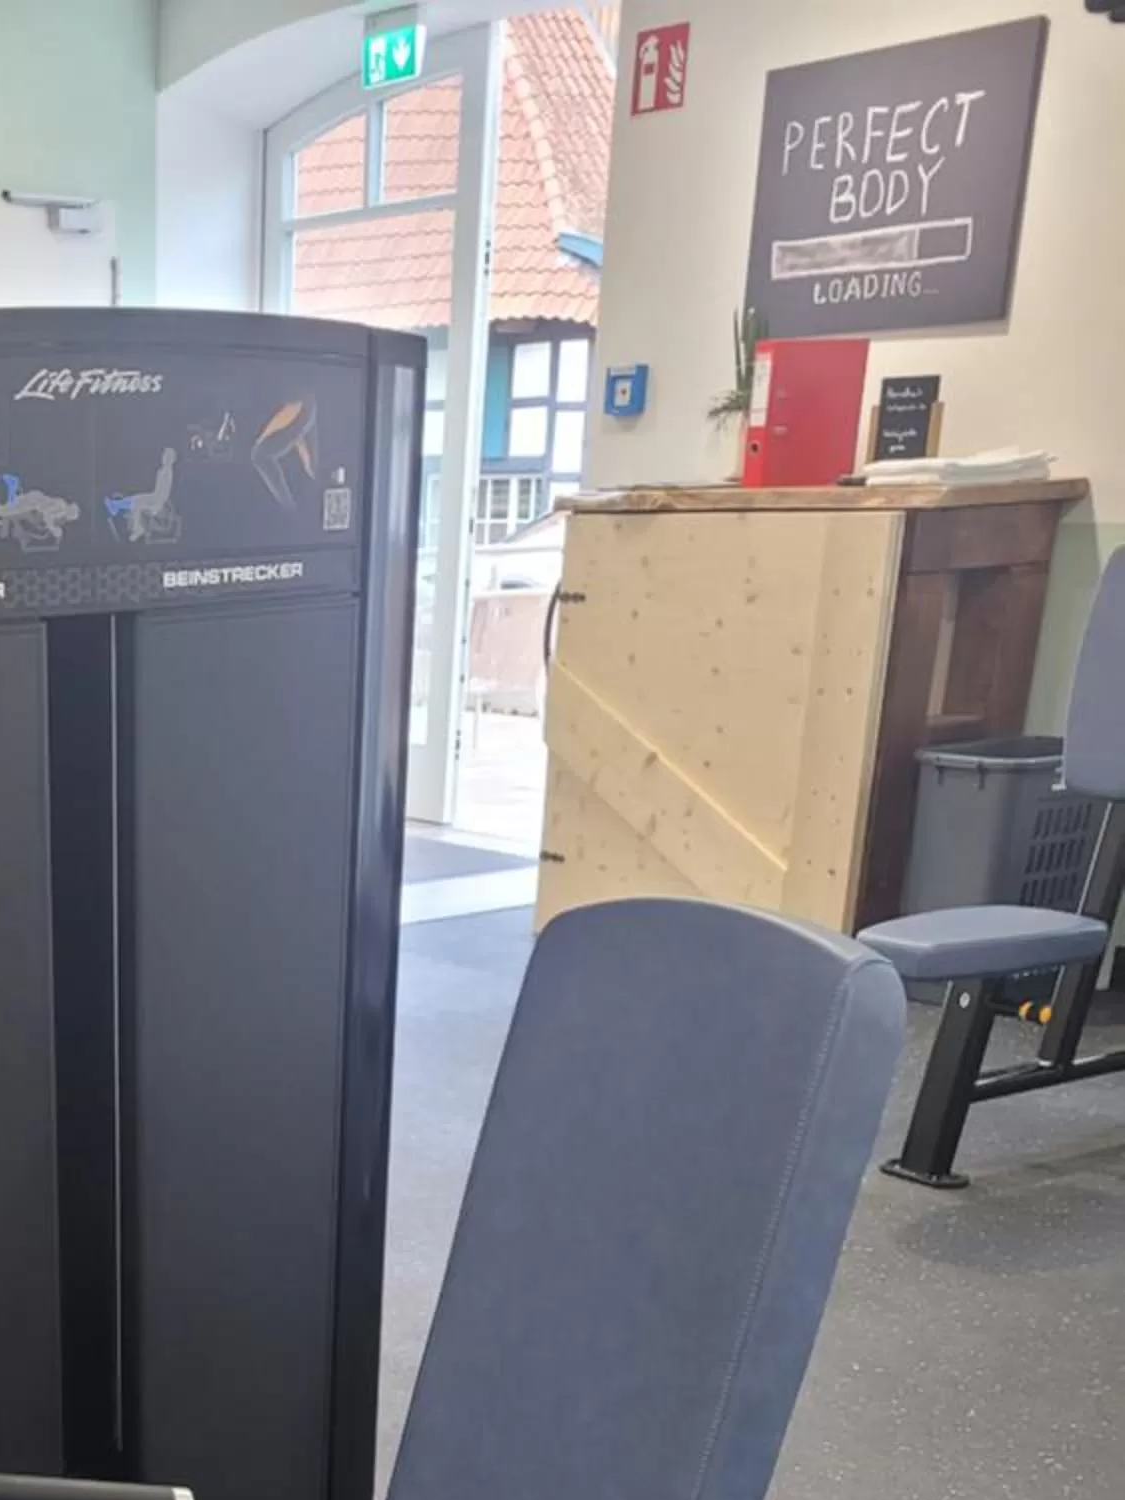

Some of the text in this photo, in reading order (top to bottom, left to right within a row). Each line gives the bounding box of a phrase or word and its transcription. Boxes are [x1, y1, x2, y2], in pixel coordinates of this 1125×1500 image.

[782, 90, 986, 176] PERFECT
[829, 155, 946, 224] BODY
[13, 368, 164, 401] Life Fitness
[162, 562, 304, 589] BEINSTRECKER
